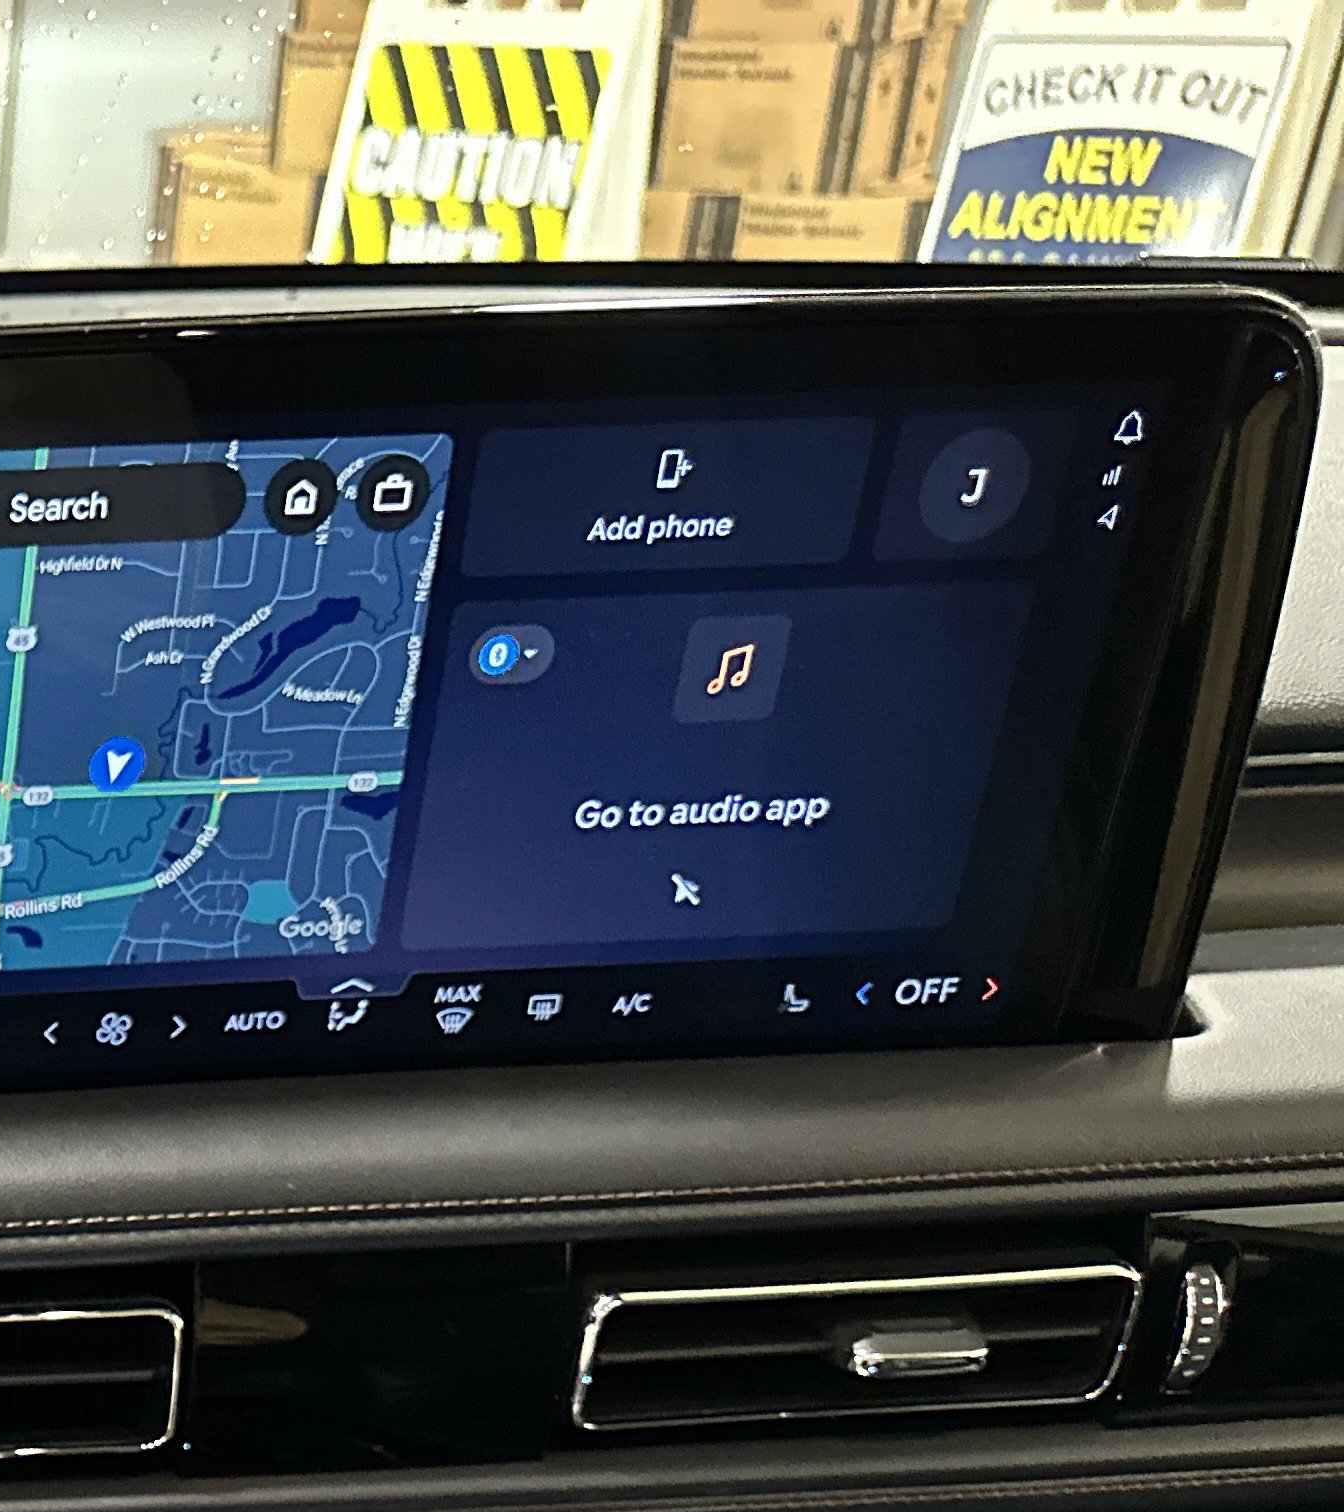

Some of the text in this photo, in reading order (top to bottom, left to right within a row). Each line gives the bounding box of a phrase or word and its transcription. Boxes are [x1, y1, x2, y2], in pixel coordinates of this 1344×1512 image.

[984, 63, 1268, 124] CHECK IT OUT
[350, 126, 583, 210] CAUTION
[1043, 135, 1163, 187] NEW
[947, 190, 1227, 245] ALIGNMENT
[959, 466, 990, 508] J
[9, 491, 109, 524] Search
[587, 512, 735, 546] Add phone
[39, 557, 124, 577] Highfield Dr N
[12, 633, 30, 647] 45
[145, 651, 170, 666] Ash
[574, 793, 831, 831] Go to audio app
[154, 824, 220, 889] Rollins Rd
[4, 892, 84, 920] Rollins Rd
[278, 912, 363, 941] Google
[433, 983, 483, 1004] MAX
[611, 992, 653, 1016] A/C
[894, 976, 960, 1007] OFF
[223, 1010, 286, 1034] AUTO
